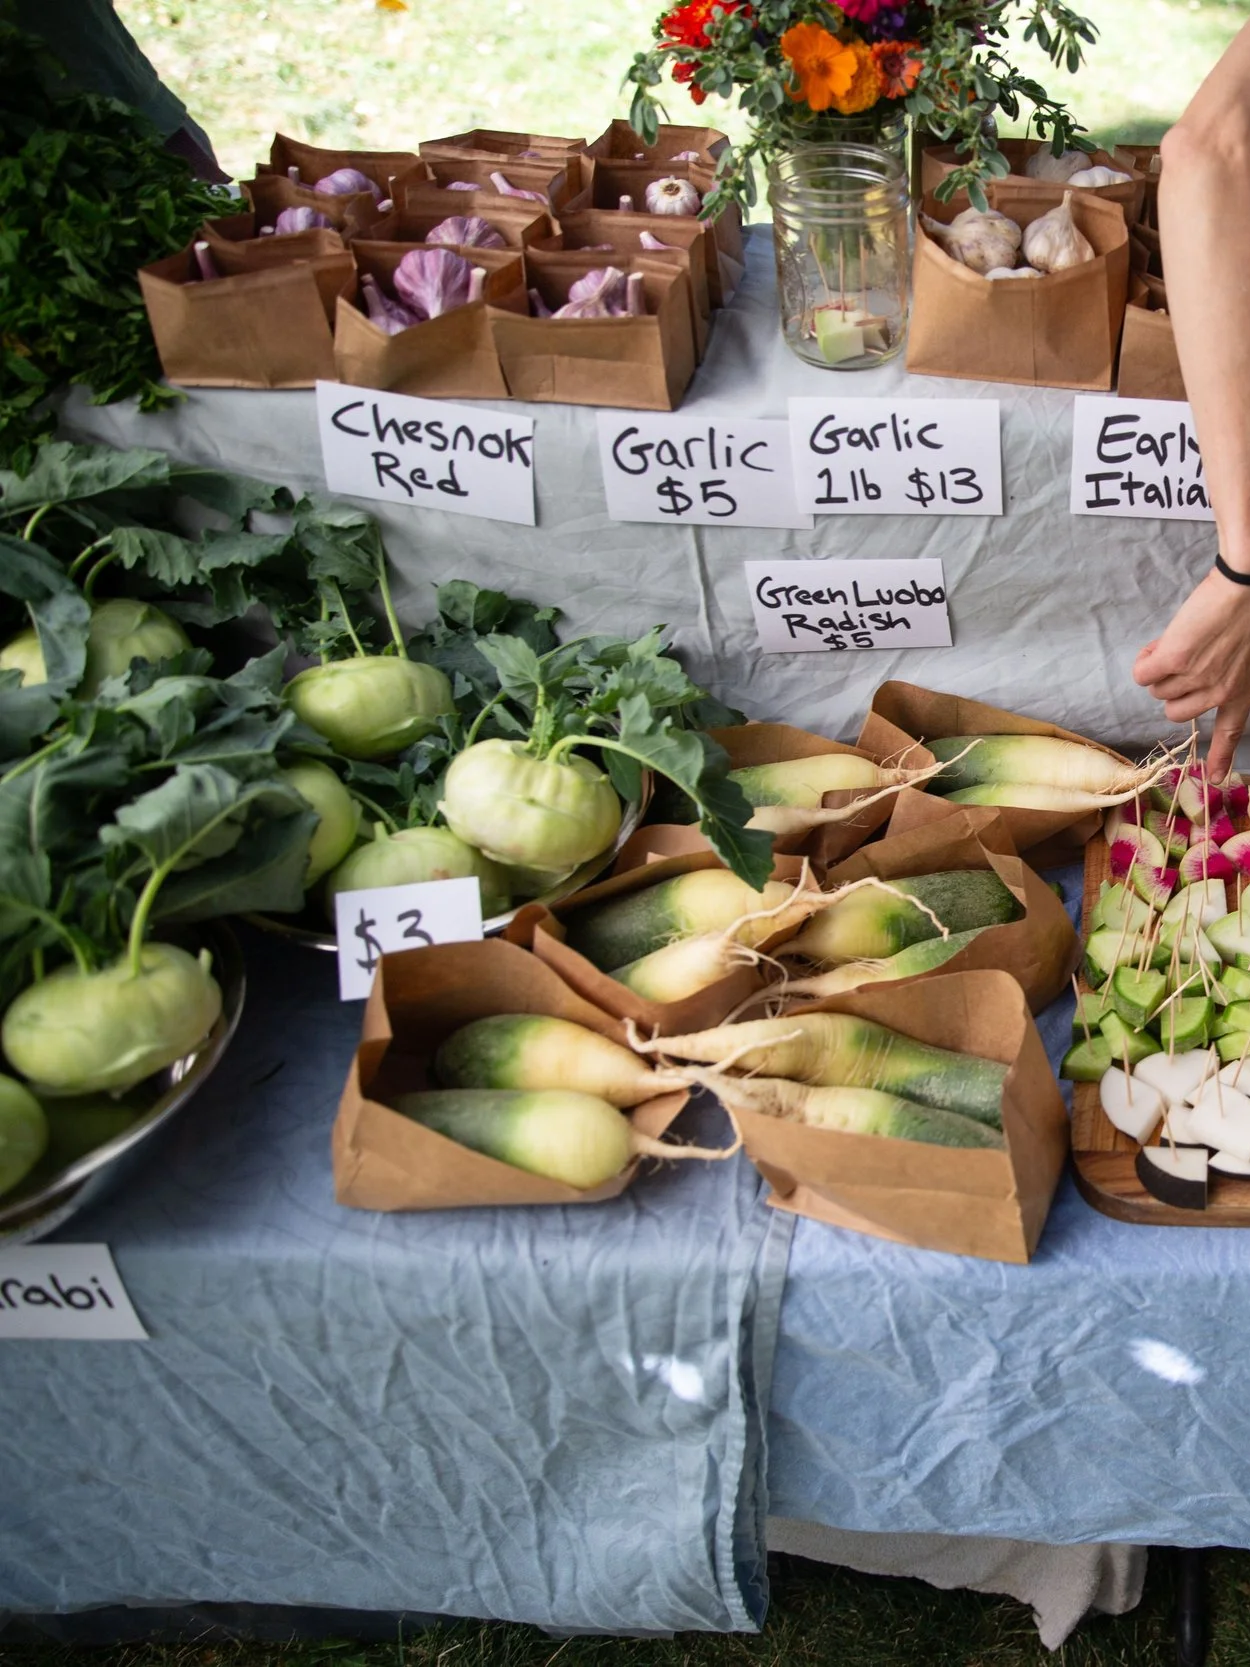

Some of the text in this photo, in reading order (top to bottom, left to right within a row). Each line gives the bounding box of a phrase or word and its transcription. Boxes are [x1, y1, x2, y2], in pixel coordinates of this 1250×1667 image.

[612, 427, 775, 475] Garlic
[809, 413, 944, 455] Garlic
[1096, 414, 1203, 478] Early
[371, 451, 469, 497] Red
[815, 467, 983, 507] 1lb $13
[1085, 471, 1212, 509] Italia
[657, 476, 737, 517] $5
[756, 576, 848, 608] Green
[782, 610, 911, 638] Radish
[823, 632, 874, 650] $5
[0, 1273, 114, 1310] rabi
